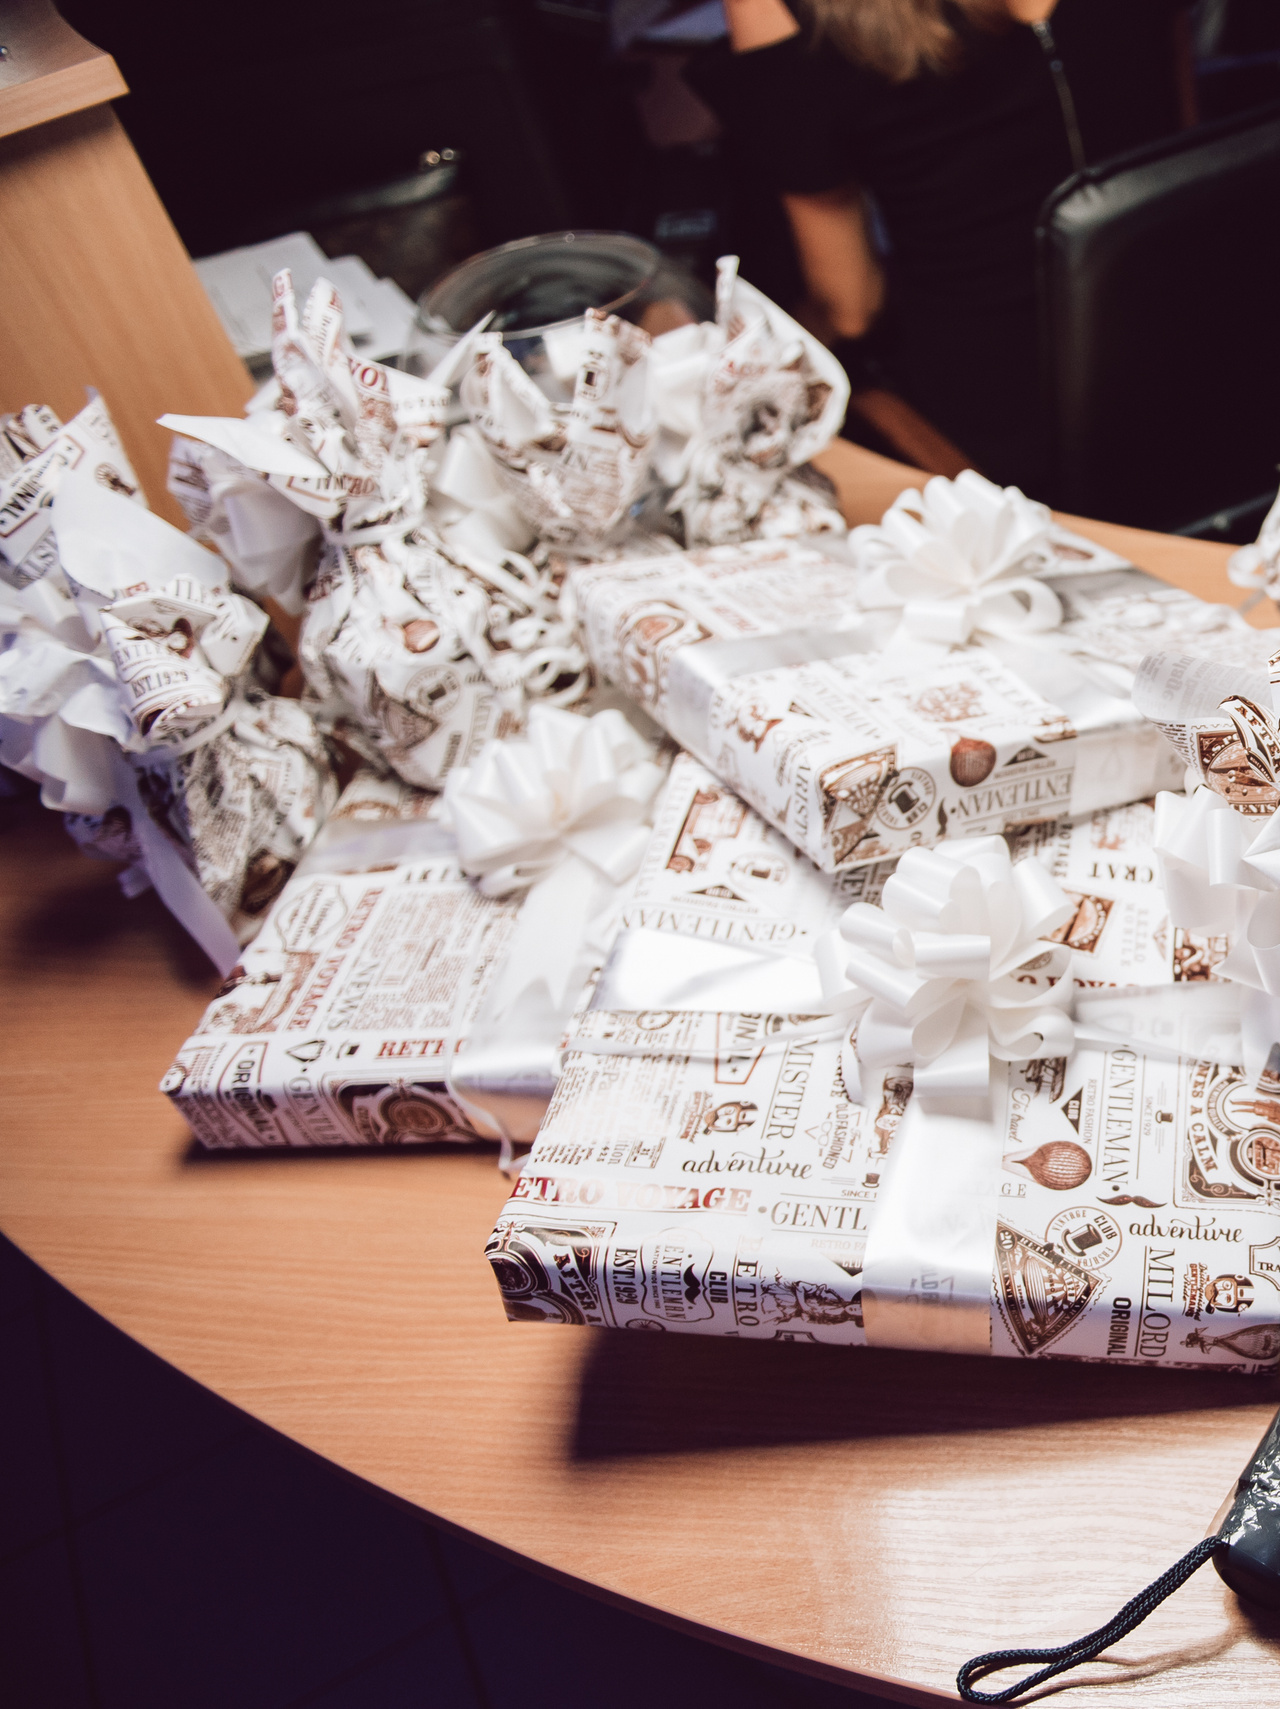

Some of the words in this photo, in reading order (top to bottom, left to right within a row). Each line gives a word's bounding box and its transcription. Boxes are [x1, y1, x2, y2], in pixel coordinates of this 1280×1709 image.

[766, 1037, 819, 1140] MISTER
[1087, 1078, 1098, 1108] RETRO
[1102, 1049, 1138, 1185] GENTLEMAN
[1144, 1096, 1154, 1117] SINCE
[1190, 1105, 1203, 1116] A
[1082, 1108, 1095, 1145] FASHION
[682, 1147, 814, 1180] adventure
[1191, 1122, 1219, 1173] CALM
[615, 1180, 752, 1212] VOYAGE
[841, 1189, 867, 1199] SINCE
[1051, 1209, 1087, 1232] VINTAGE
[1093, 1214, 1118, 1240] CLUB
[1129, 1213, 1245, 1243] adventure
[612, 1247, 639, 1306] EST.1929
[708, 1271, 729, 1304] CLUB
[1184, 1263, 1198, 1318] GENTLEMANS
[1139, 1246, 1176, 1358] MILORD
[1107, 1296, 1132, 1356] ORIGINAL
